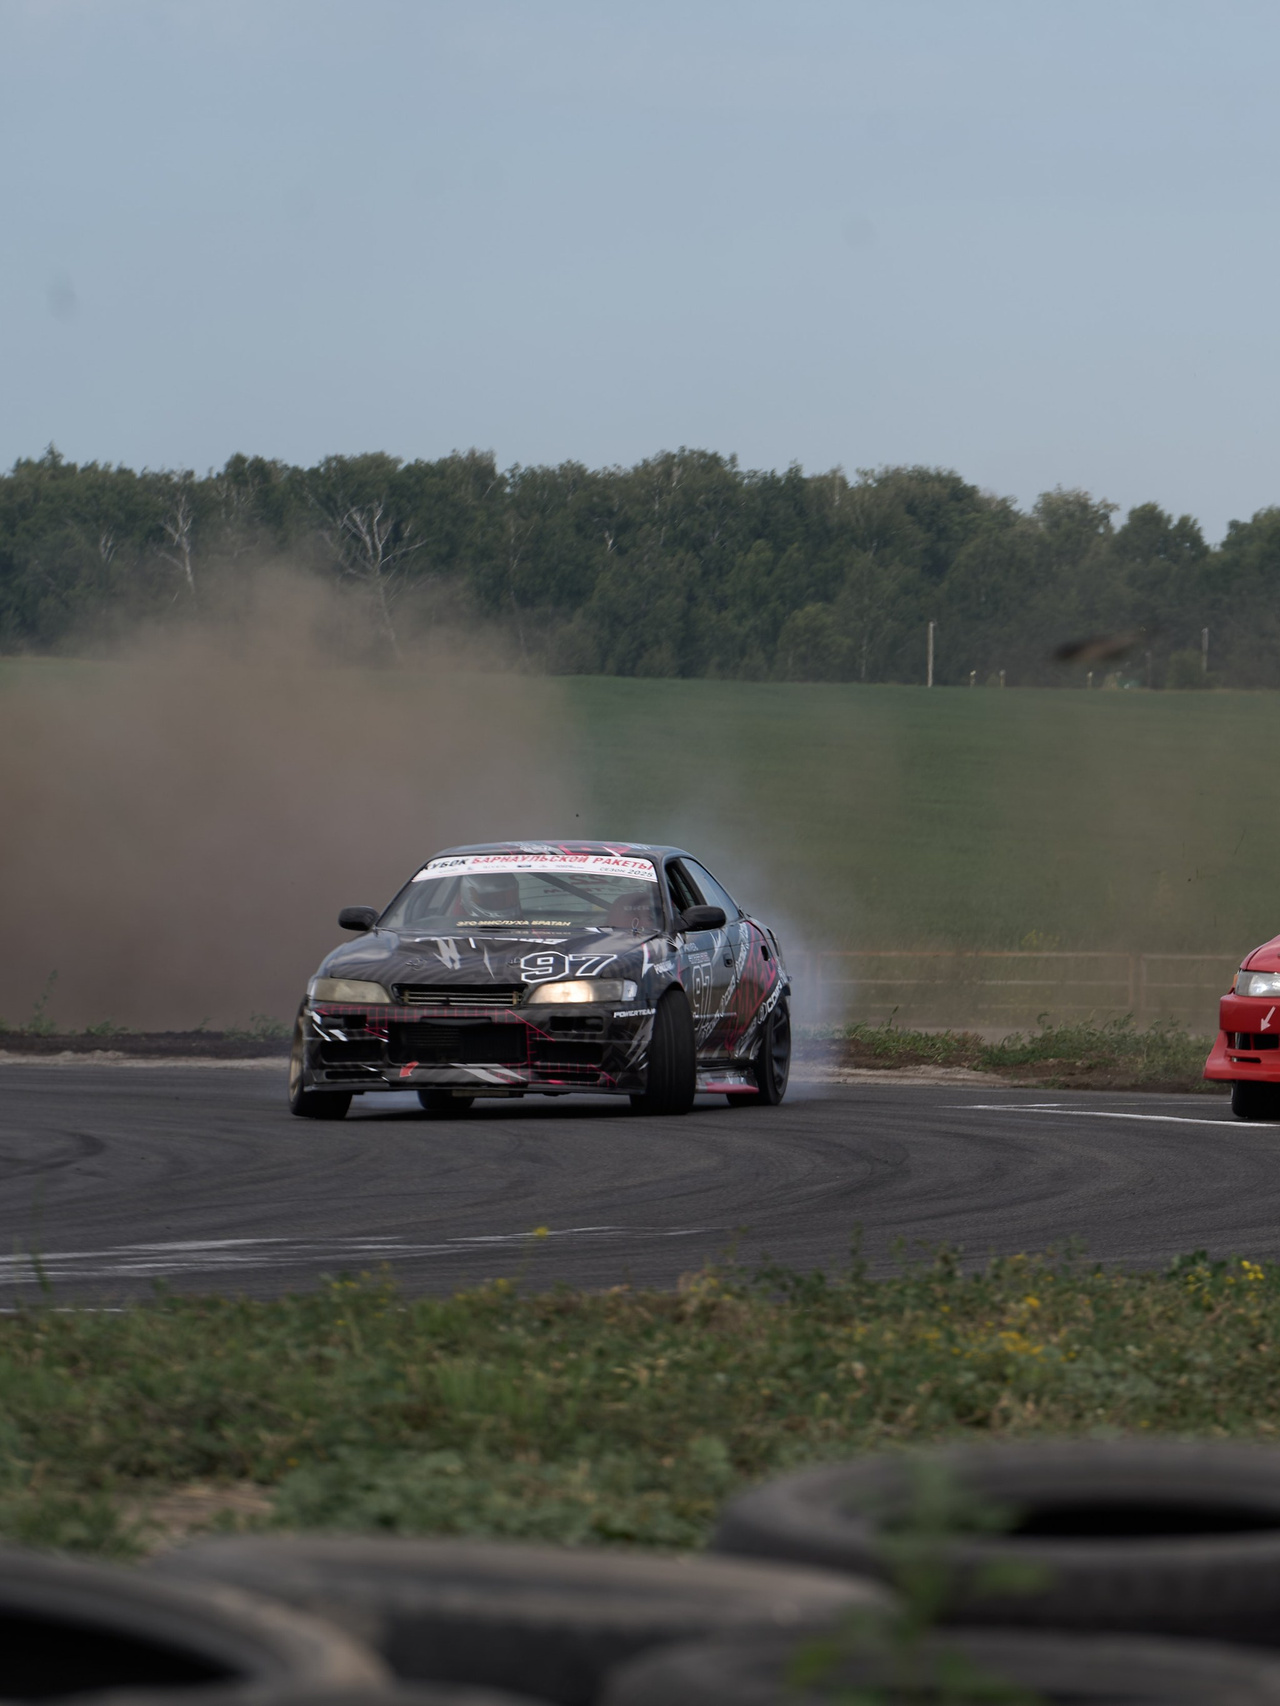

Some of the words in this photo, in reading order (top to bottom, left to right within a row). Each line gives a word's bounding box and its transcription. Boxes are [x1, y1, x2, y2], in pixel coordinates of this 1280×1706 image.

[470, 854, 590, 865] БАРНАУЛЬСКОЙ
[592, 857, 654, 871] РАКЕТЫ
[599, 866, 625, 874] СЕЗОН
[626, 869, 653, 878] 2025
[520, 950, 618, 984] 97
